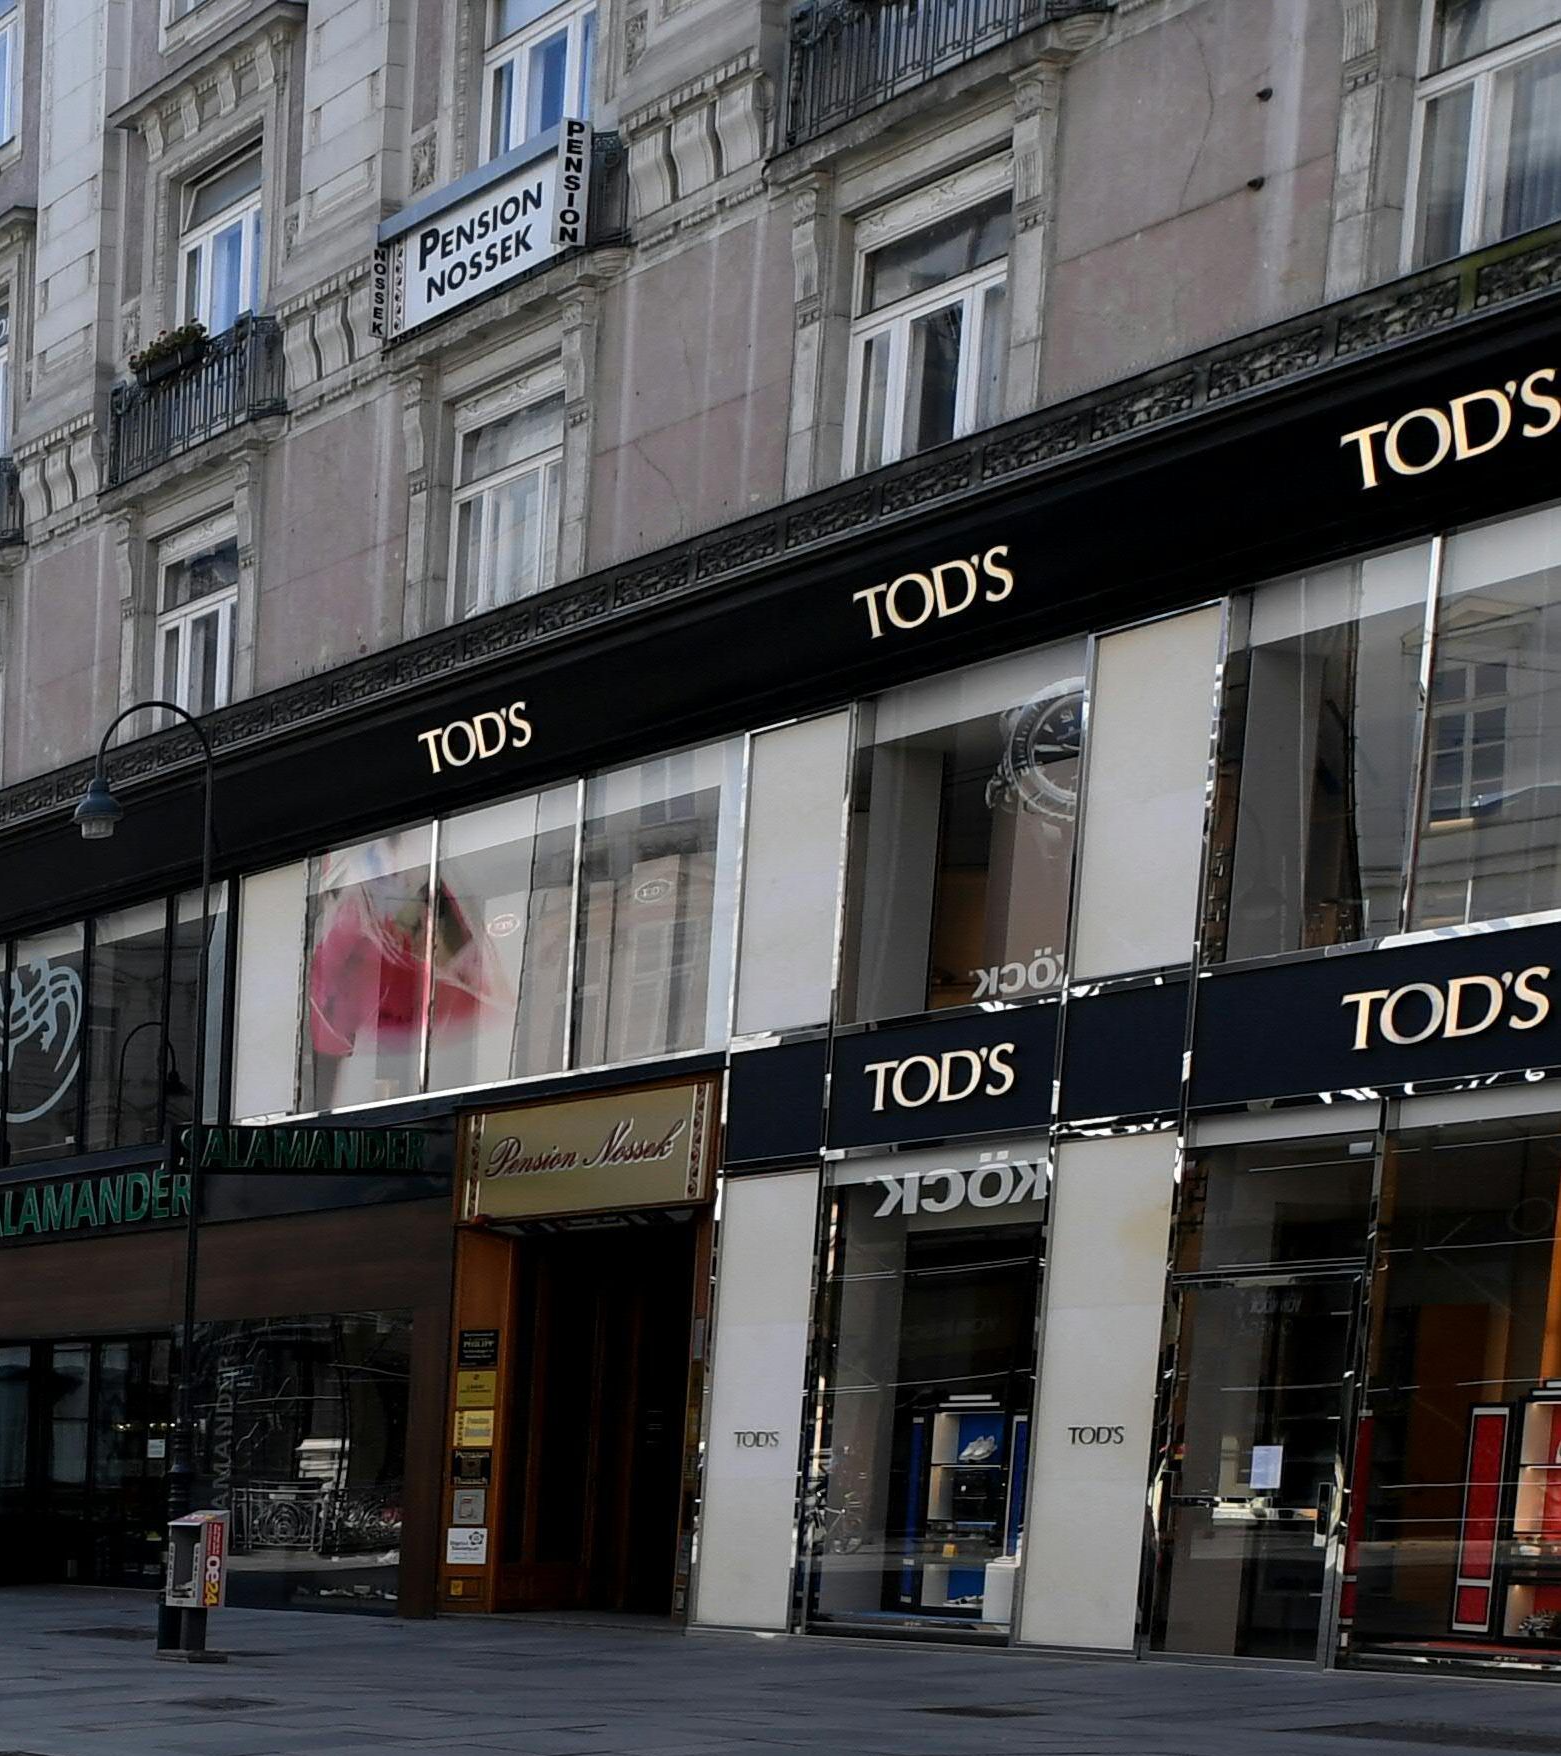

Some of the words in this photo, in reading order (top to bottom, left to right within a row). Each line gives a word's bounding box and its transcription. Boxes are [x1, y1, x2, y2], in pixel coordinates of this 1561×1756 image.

[558, 120, 585, 243] PENSION
[419, 181, 543, 272] PENSION
[426, 224, 533, 304] NOSSEK
[372, 248, 387, 335] NOSSEK
[1340, 367, 1561, 490] TOD'S
[854, 545, 1014, 638] TOD'S
[418, 700, 533, 773] TOD'S
[1340, 965, 1551, 1051] TOD'S
[864, 1042, 1016, 1112] TOD'S
[180, 1129, 427, 1170] SALAMANDER
[485, 1136, 581, 1180] Pension
[582, 1117, 687, 1170] Nossek
[734, 1431, 779, 1448] TOD'S
[1068, 1427, 1125, 1445] TOD'S
